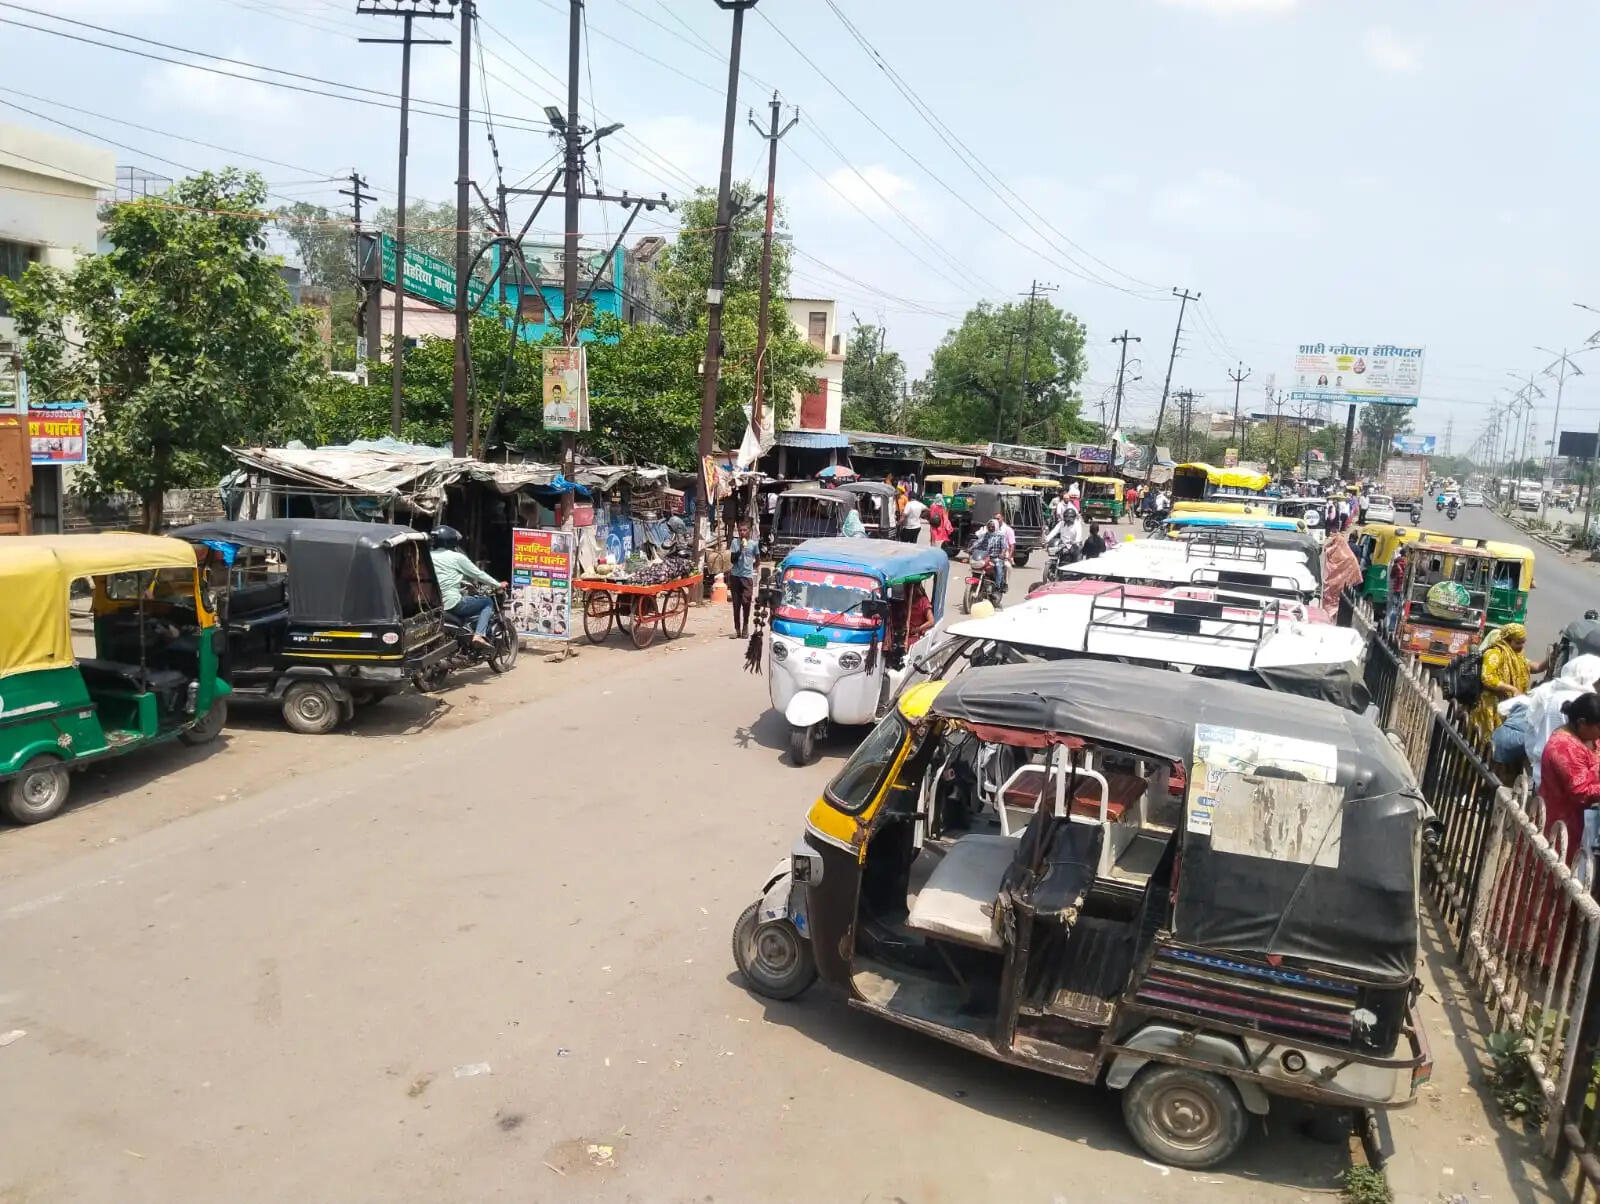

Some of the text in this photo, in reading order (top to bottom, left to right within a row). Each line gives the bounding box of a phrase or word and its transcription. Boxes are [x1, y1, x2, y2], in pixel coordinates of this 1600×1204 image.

[1299, 343, 1422, 357] शाही ग्लोबल हॉस्पिटल
